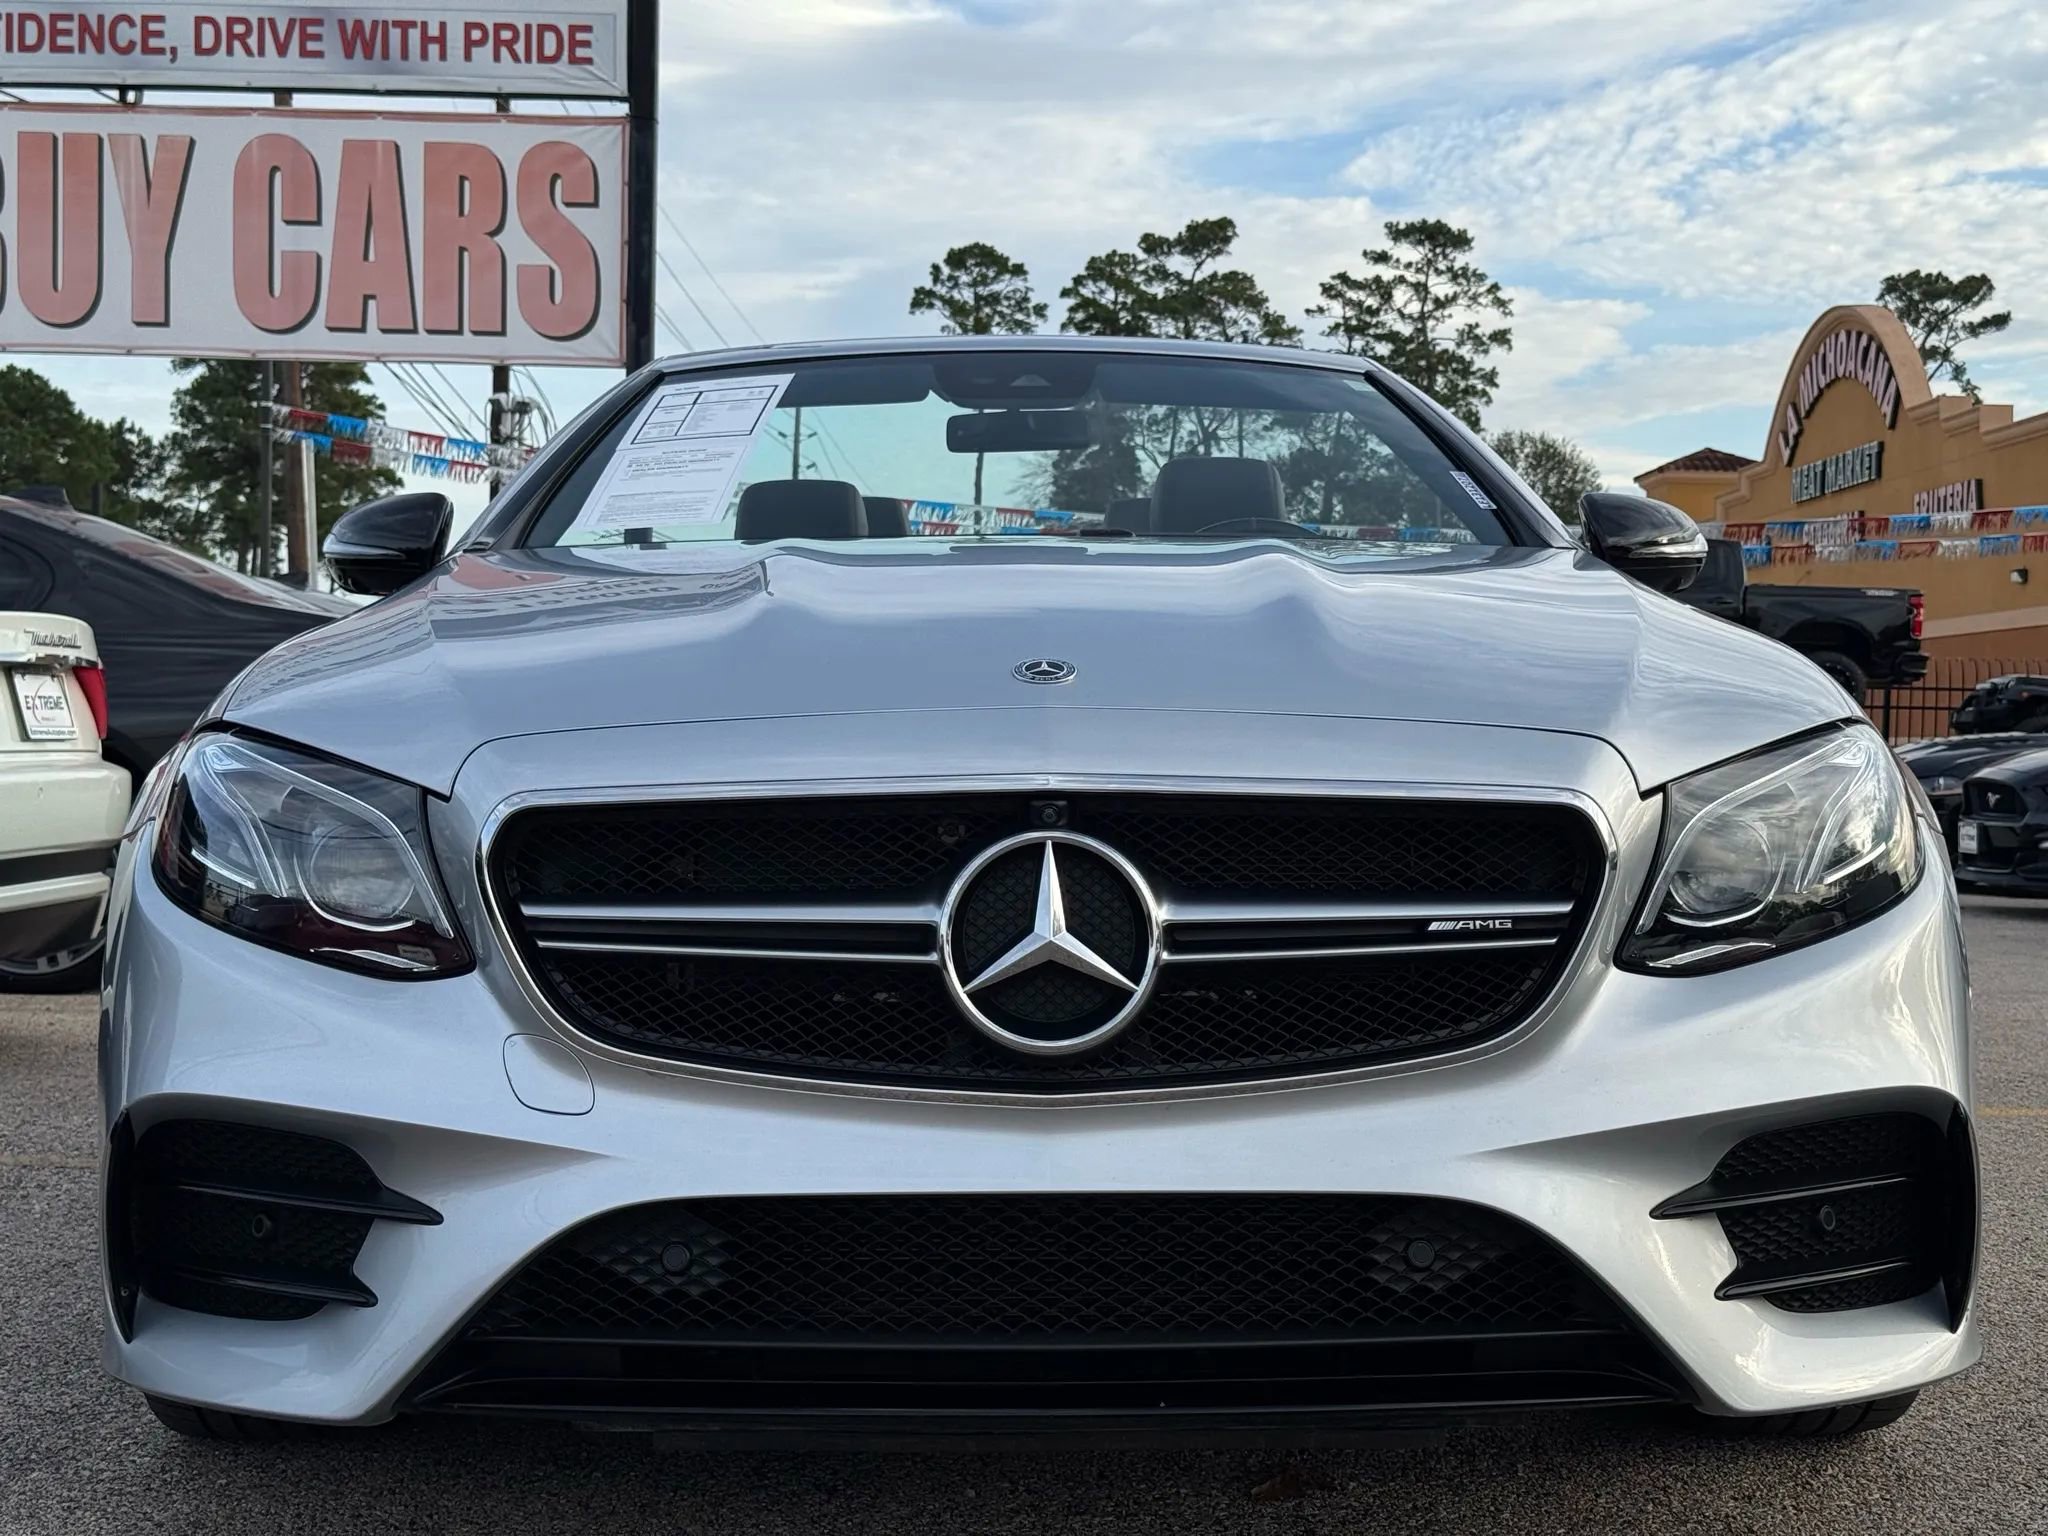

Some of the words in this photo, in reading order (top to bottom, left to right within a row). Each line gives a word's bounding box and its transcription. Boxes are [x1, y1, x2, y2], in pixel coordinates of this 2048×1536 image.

[0, 12, 178, 63] IDENCE,
[194, 16, 325, 58] DRIVE
[337, 18, 447, 62] WITH
[463, 21, 594, 65] PRIDE
[0, 130, 195, 328] UY
[233, 133, 600, 340] CARS
[1778, 403, 1801, 467] LA
[1799, 329, 1898, 430] MICHOACANA
[1791, 461, 1824, 503] MEAT
[1825, 440, 1880, 494] MARKET
[1455, 919, 1513, 930] AMG
